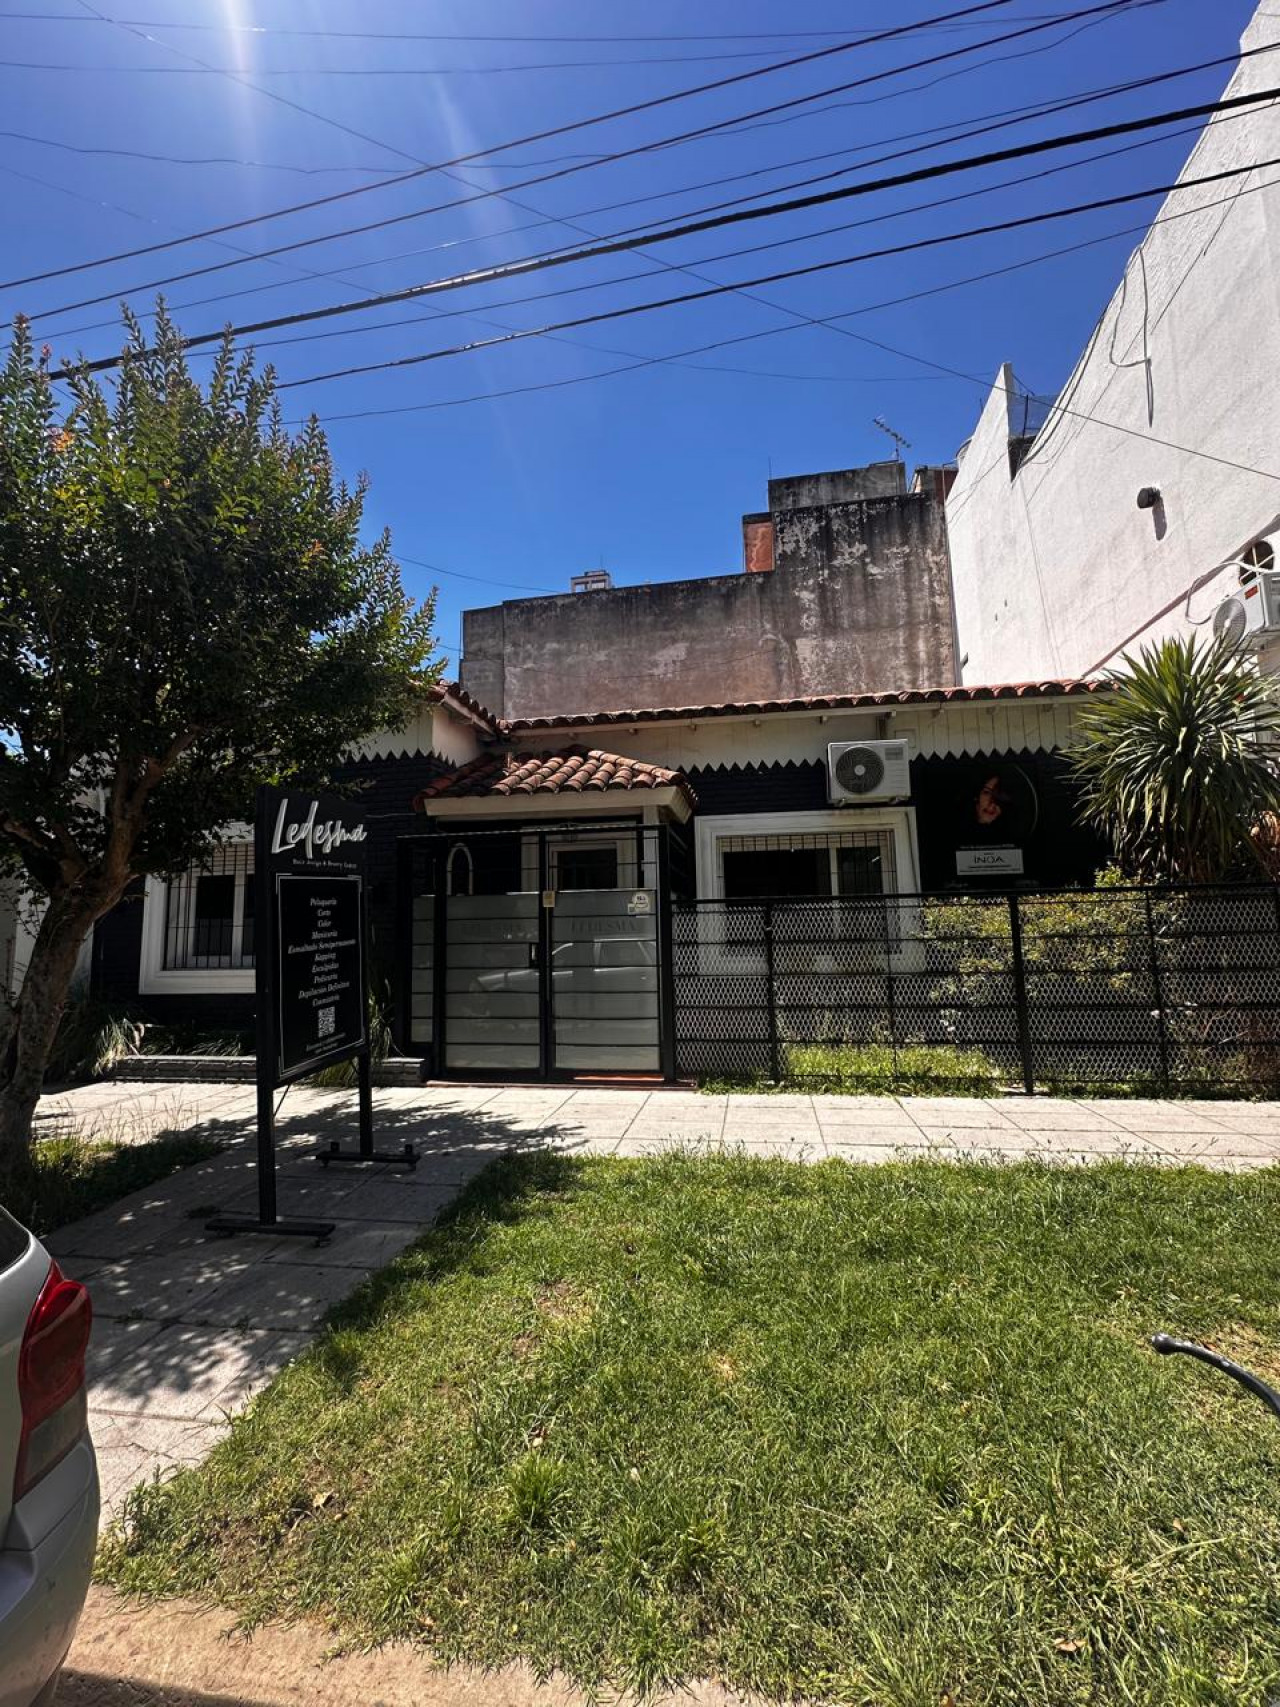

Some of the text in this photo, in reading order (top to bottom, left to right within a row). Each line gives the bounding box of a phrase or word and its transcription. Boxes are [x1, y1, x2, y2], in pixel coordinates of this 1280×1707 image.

[270, 798, 368, 859] Ledesma
[975, 856, 1005, 864] INOA
[317, 919, 331, 928] Color
